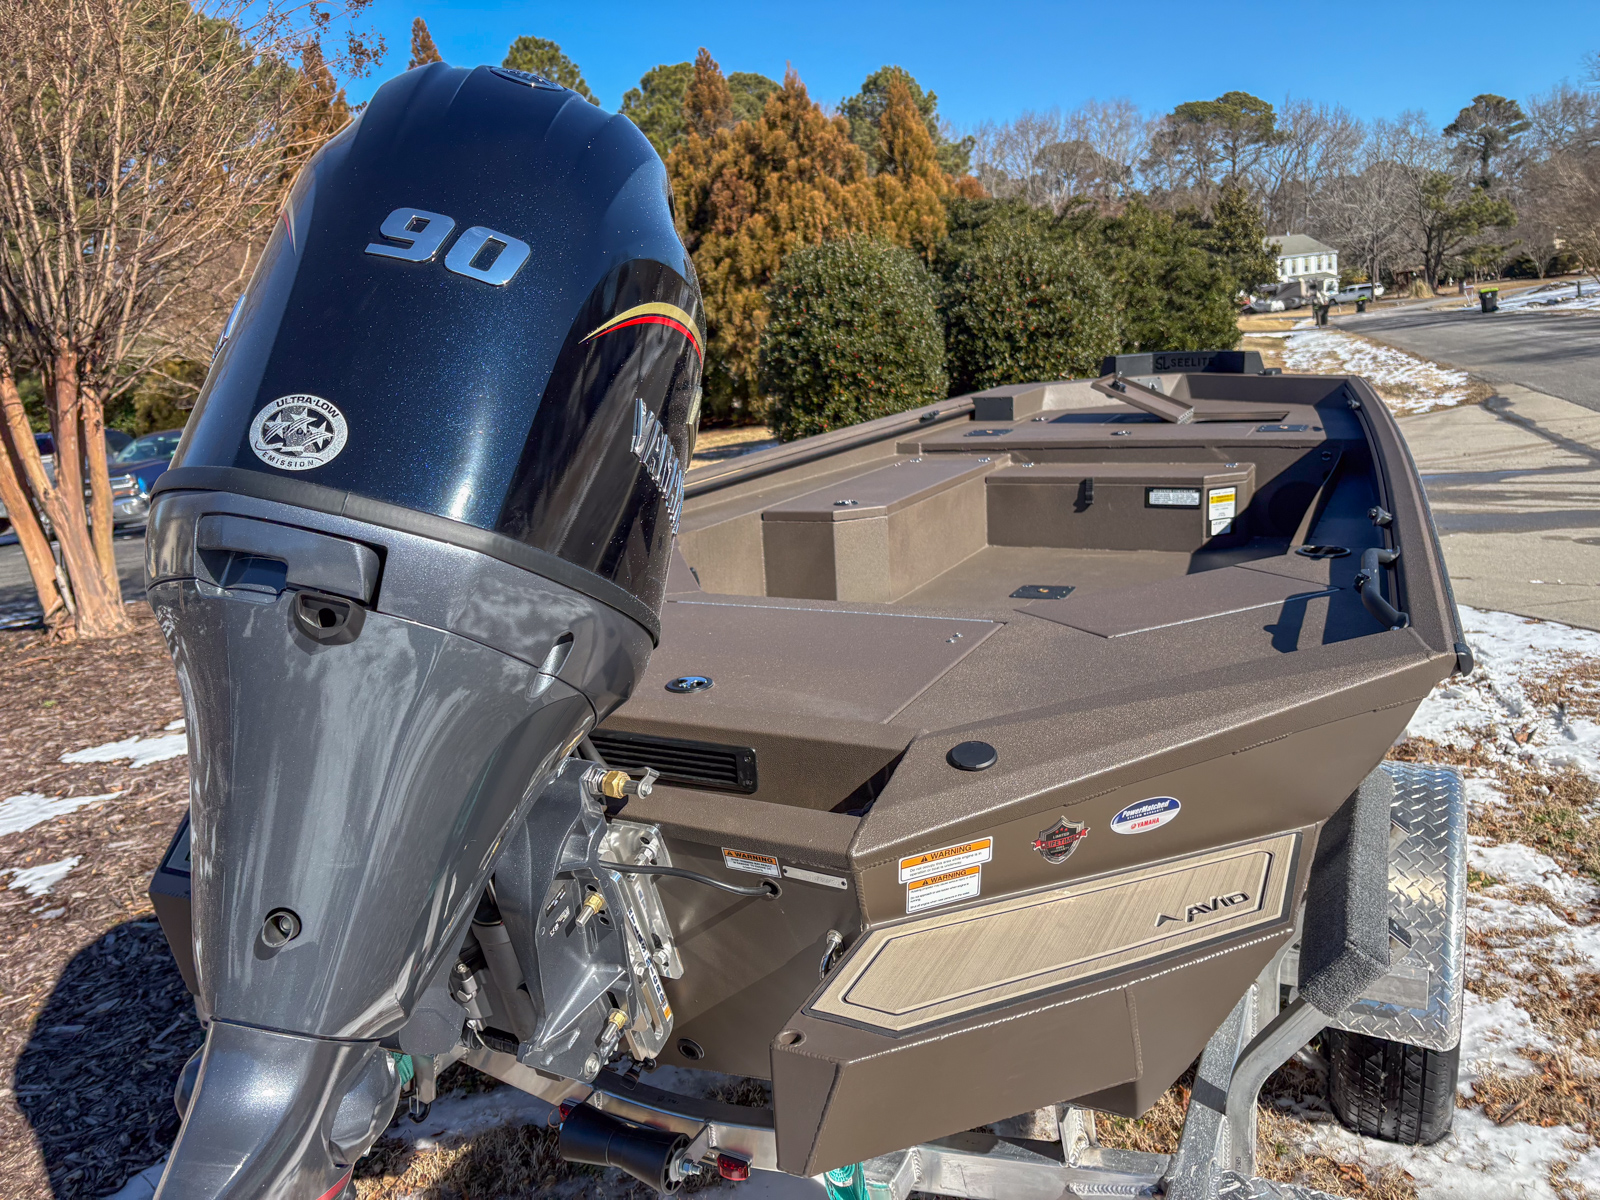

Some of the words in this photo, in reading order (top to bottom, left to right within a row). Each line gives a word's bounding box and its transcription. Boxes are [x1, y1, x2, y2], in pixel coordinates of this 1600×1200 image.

[364, 207, 532, 287] 90
[1171, 357, 1216, 368] SEELITE
[261, 451, 314, 467] EMISSION
[1122, 800, 1171, 818] PowerMatched
[1137, 818, 1160, 828] YAMAHA
[1046, 836, 1075, 848] LIFETIME
[735, 852, 773, 864] WARNING
[930, 844, 972, 860] WARNING
[930, 869, 967, 883] WARNING
[1184, 891, 1250, 922] AVID
